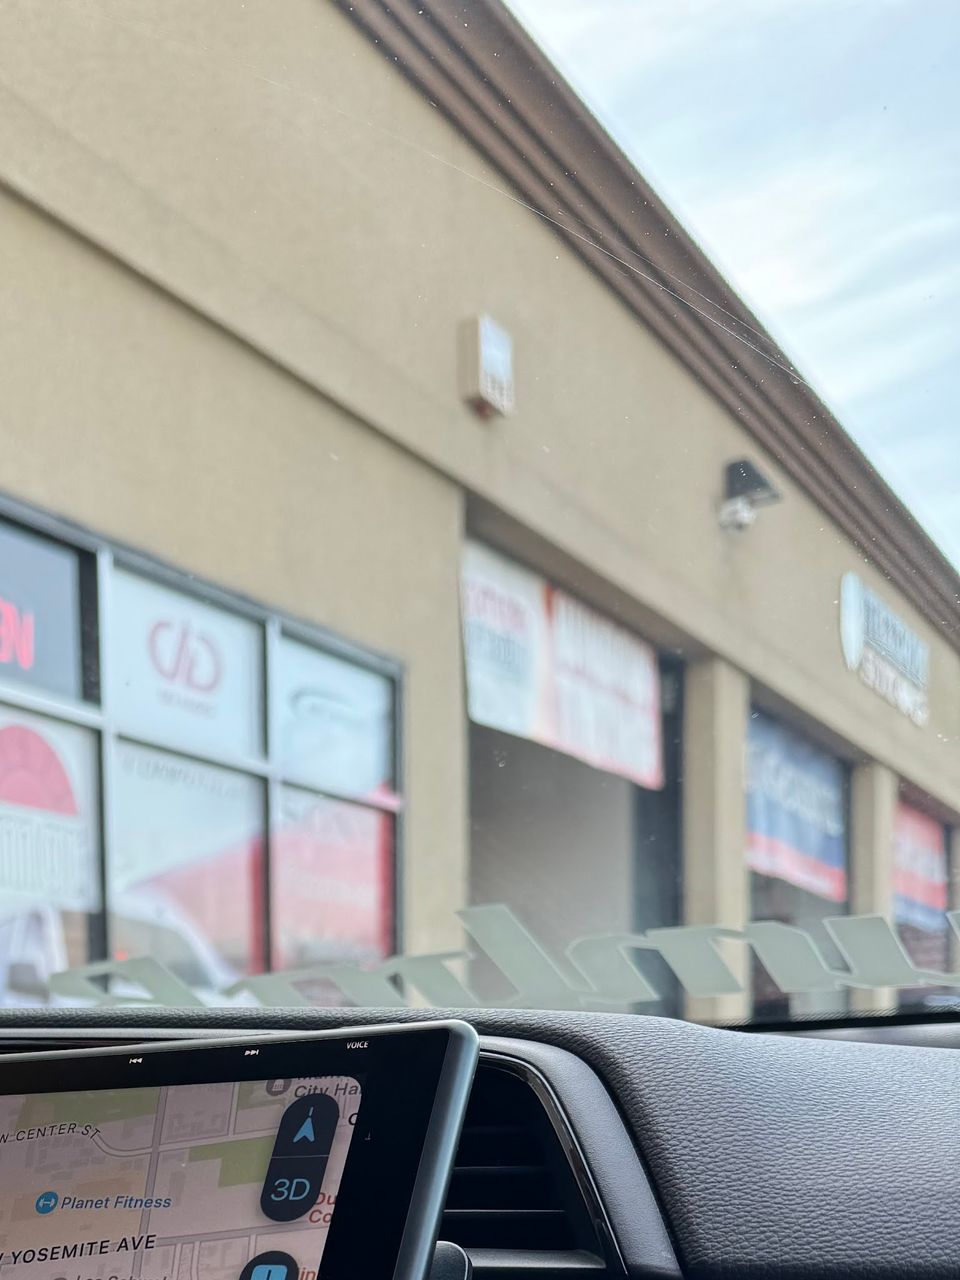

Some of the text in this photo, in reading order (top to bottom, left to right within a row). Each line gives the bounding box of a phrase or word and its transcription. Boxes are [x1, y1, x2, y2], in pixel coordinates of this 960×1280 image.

[346, 1040, 369, 1050] VOICE
[334, 1082, 361, 1096] Ha
[16, 1122, 77, 1142] CENTER
[81, 1124, 101, 1140] ST
[271, 1178, 311, 1201] 3D
[60, 1195, 172, 1209] Planet Fitness
[11, 1239, 110, 1265] YOSEMITE
[116, 1234, 157, 1252] AVE
